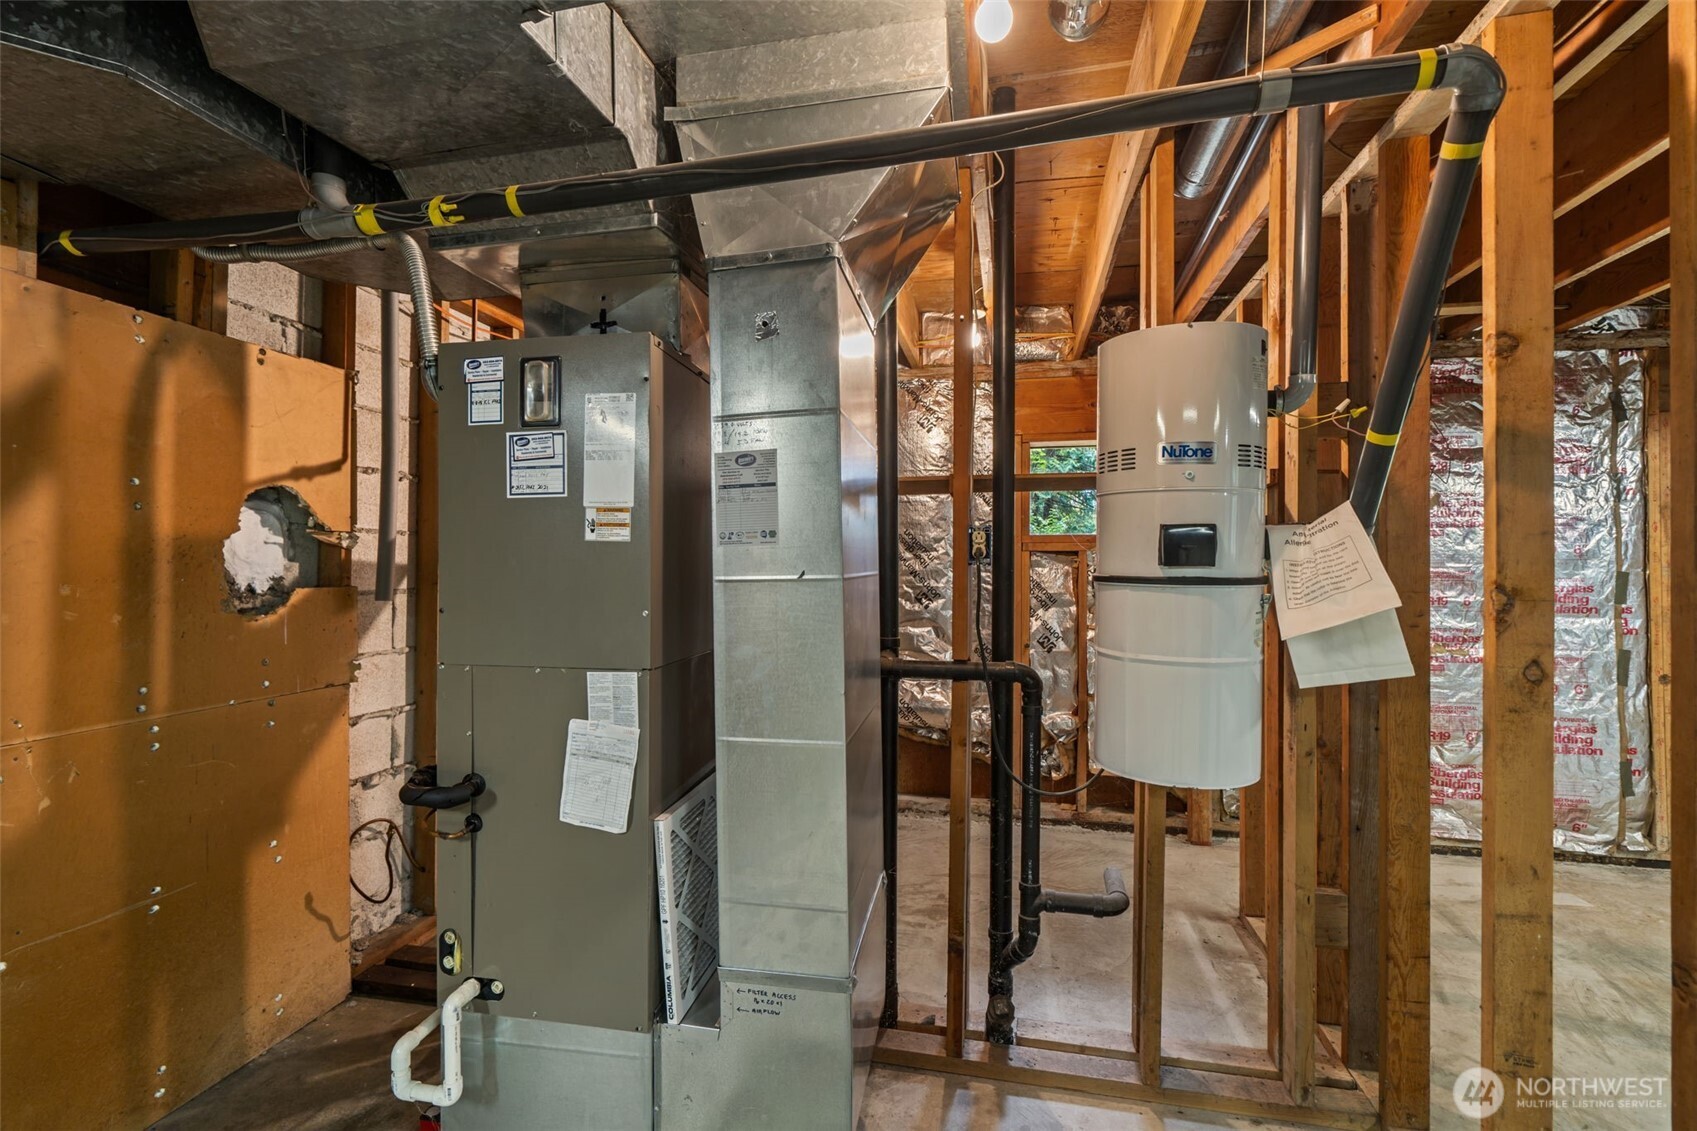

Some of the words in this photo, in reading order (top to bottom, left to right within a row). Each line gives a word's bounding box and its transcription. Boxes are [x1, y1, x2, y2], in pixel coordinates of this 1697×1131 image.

[1161, 445, 1214, 458] NuTone
[666, 975, 675, 1020] COLUMBIA
[772, 991, 796, 1001] ACCESS
